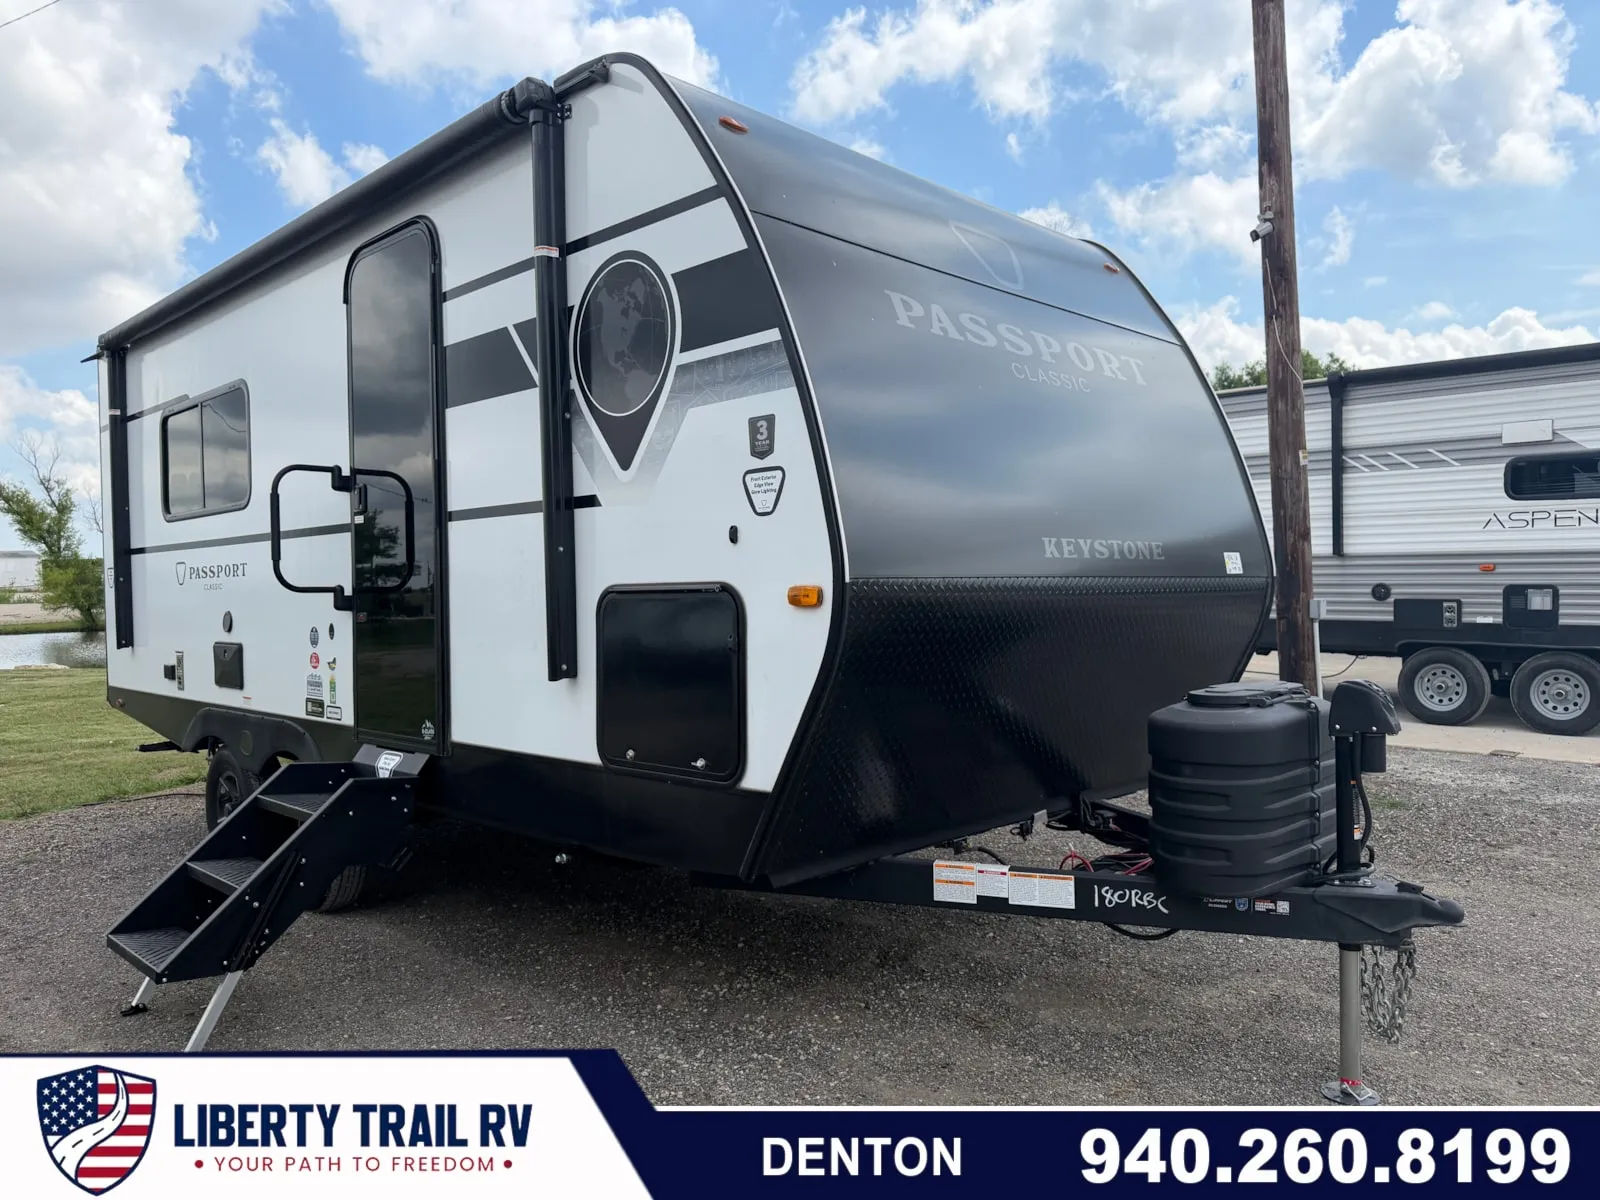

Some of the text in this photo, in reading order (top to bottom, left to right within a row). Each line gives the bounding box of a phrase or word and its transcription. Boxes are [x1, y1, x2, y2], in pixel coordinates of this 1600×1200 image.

[884, 290, 1148, 387] PASSPORT
[1011, 362, 1091, 393] CLASSIC
[756, 420, 768, 440] 3
[1482, 508, 1599, 529] ASPEN
[1042, 537, 1165, 561] KEYSTONE
[189, 562, 247, 580] PASSPORT
[203, 583, 223, 591] CLASSIC
[1094, 885, 1169, 914] 180RBC
